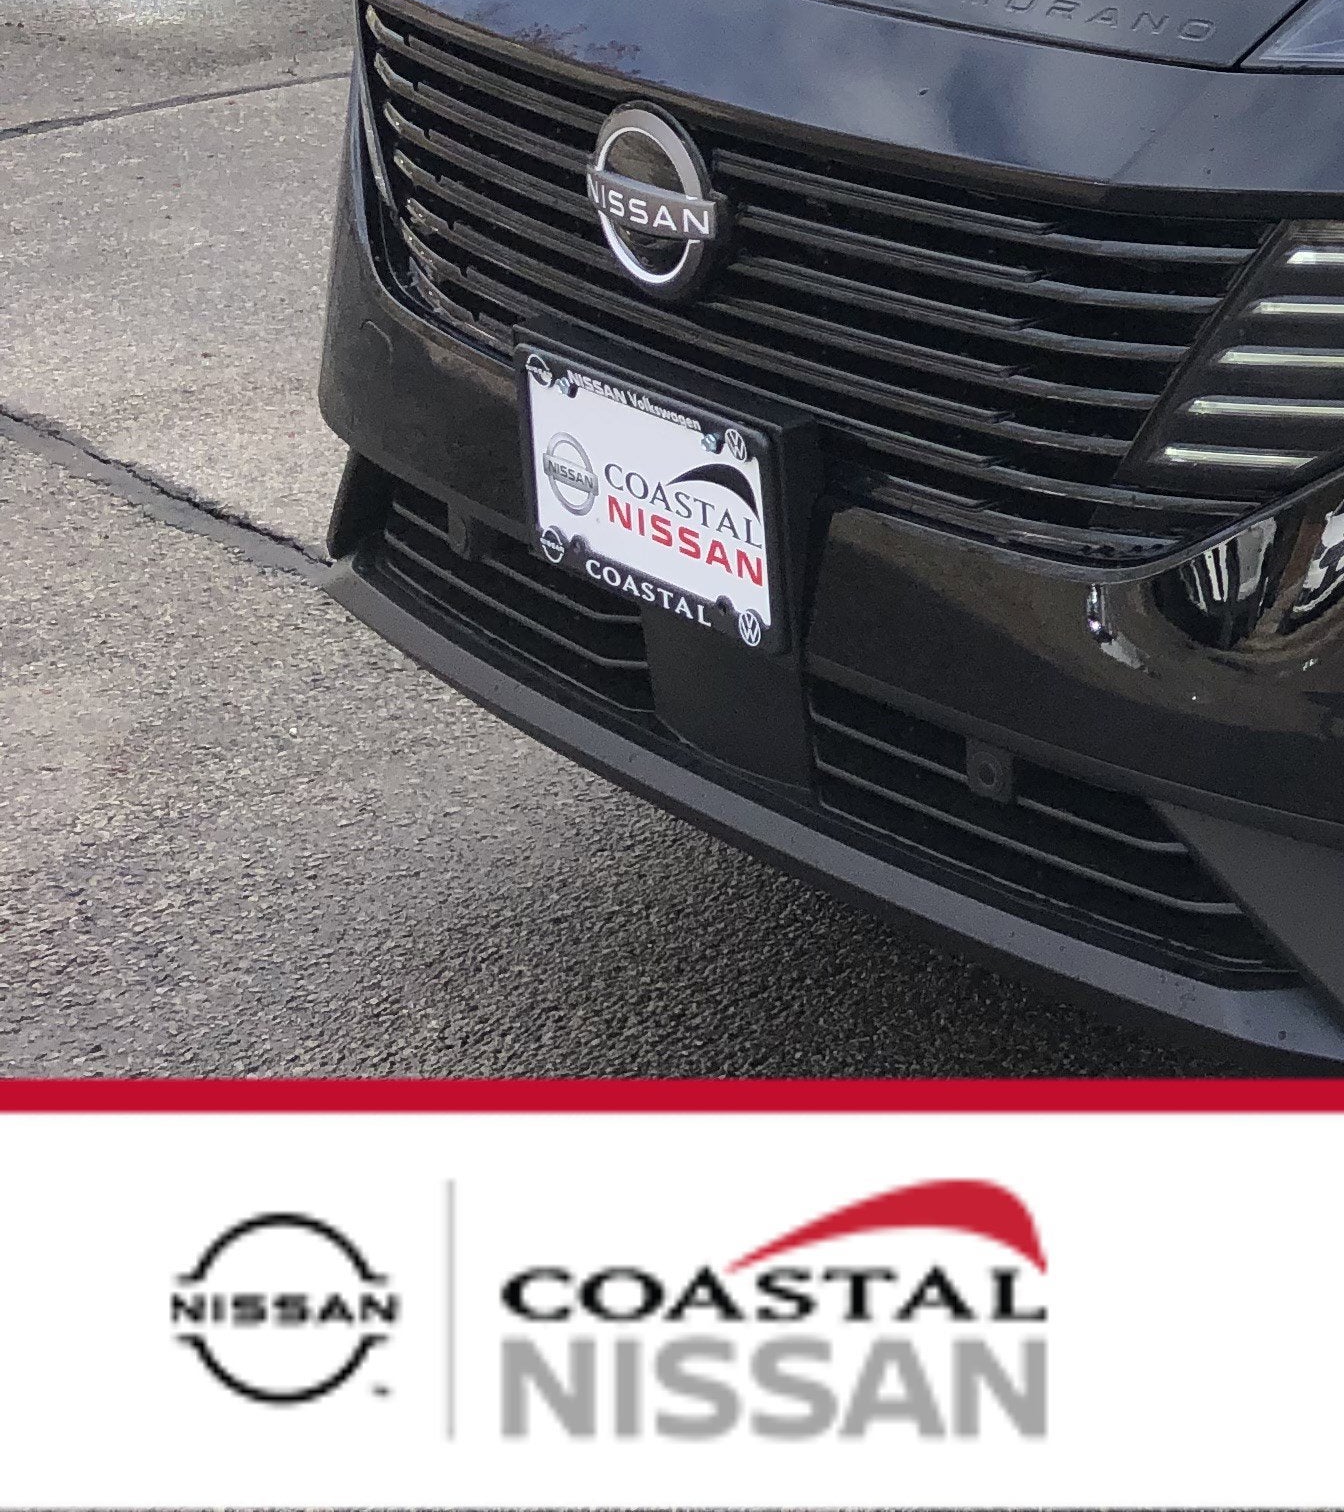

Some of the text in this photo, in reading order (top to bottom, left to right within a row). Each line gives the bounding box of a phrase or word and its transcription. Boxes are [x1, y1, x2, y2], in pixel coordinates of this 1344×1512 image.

[587, 176, 711, 237] NISSAN
[566, 369, 628, 406] NISSAN
[629, 390, 701, 431] Volkswagen
[547, 459, 594, 491] NISSAN
[604, 463, 763, 550] COASTAL
[607, 494, 764, 587] NISSAN
[585, 559, 712, 628] COASTAL
